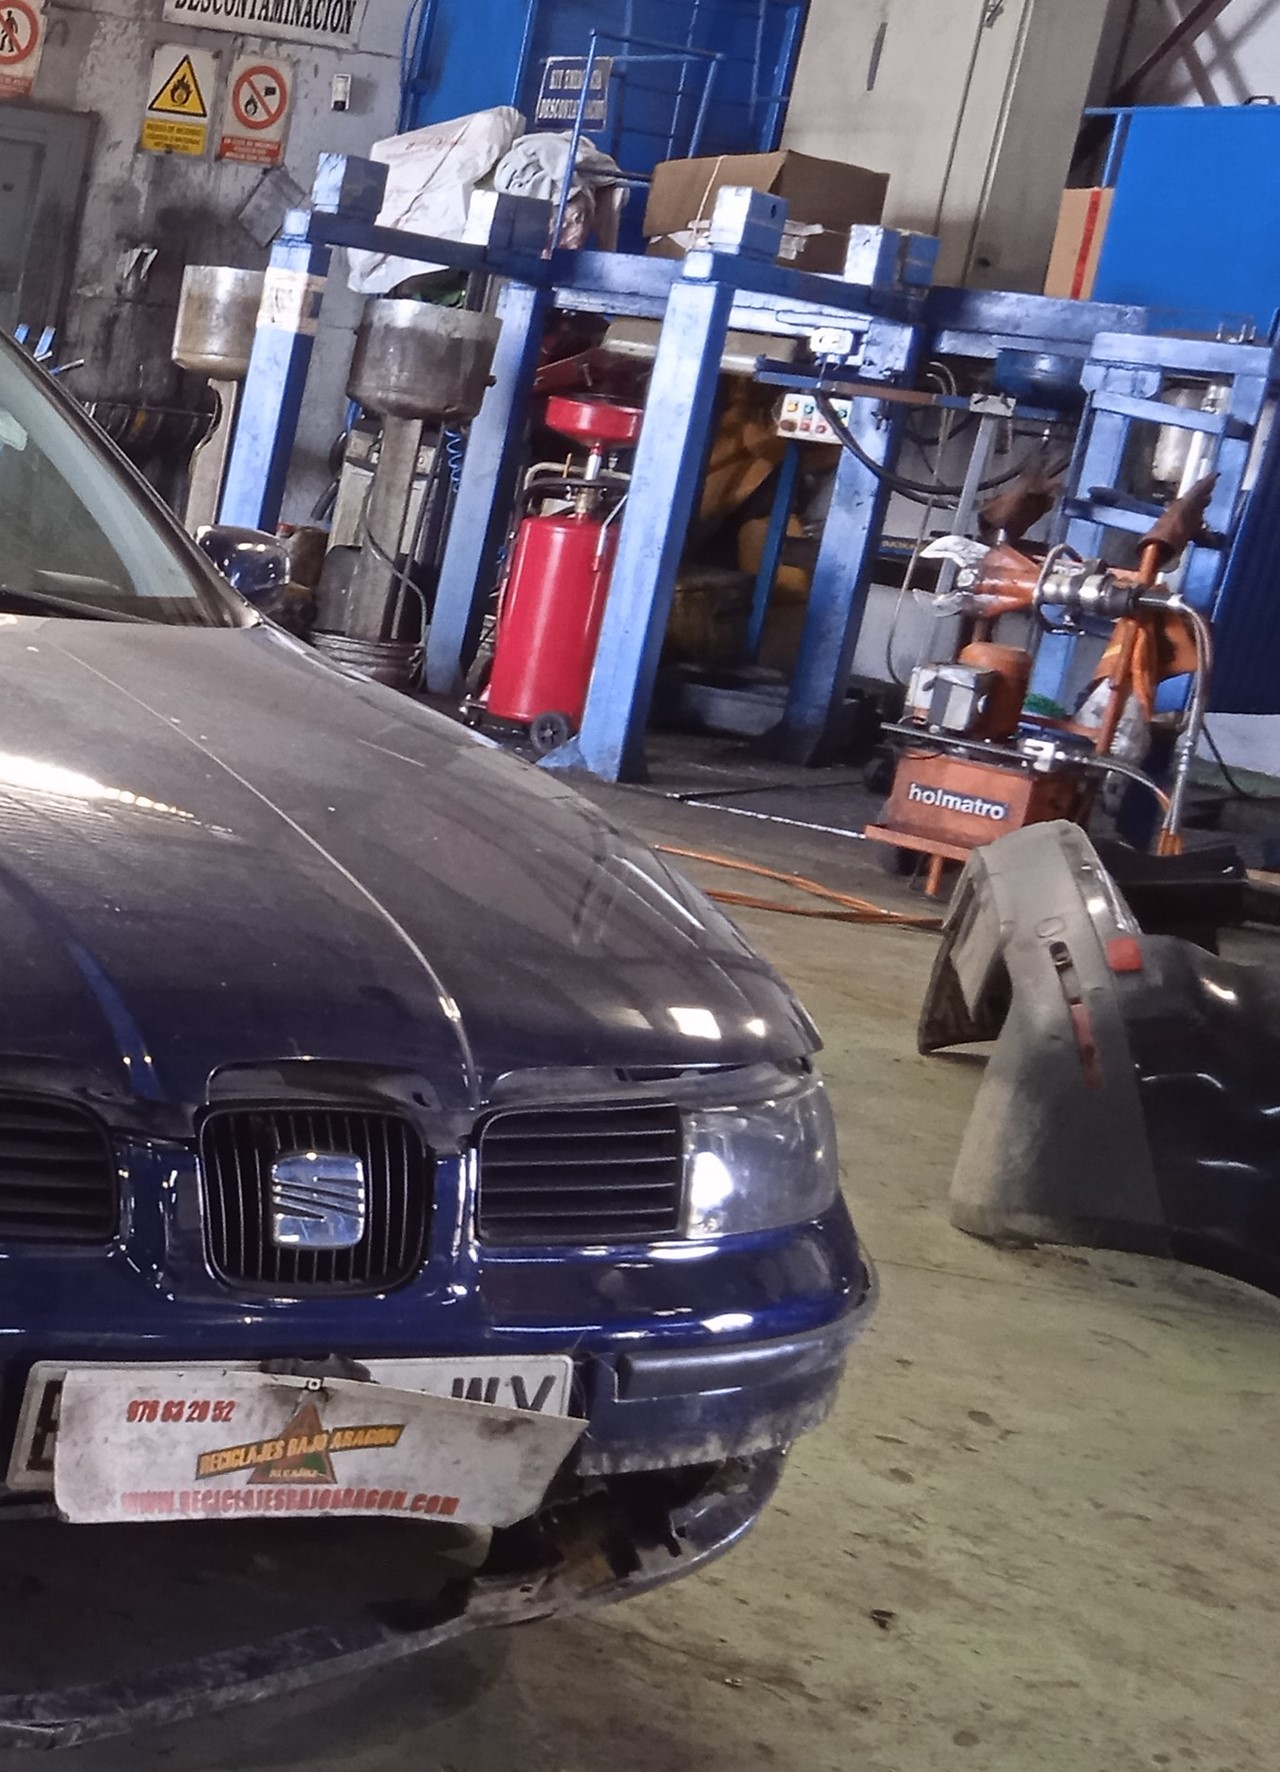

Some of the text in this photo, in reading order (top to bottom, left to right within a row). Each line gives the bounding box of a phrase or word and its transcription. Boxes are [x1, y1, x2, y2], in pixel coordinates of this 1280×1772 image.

[908, 783, 1005, 820] holmatro
[211, 1399, 236, 1423] 52
[198, 1439, 285, 1476] RECICLAJES
[287, 1432, 329, 1458] BAJO
